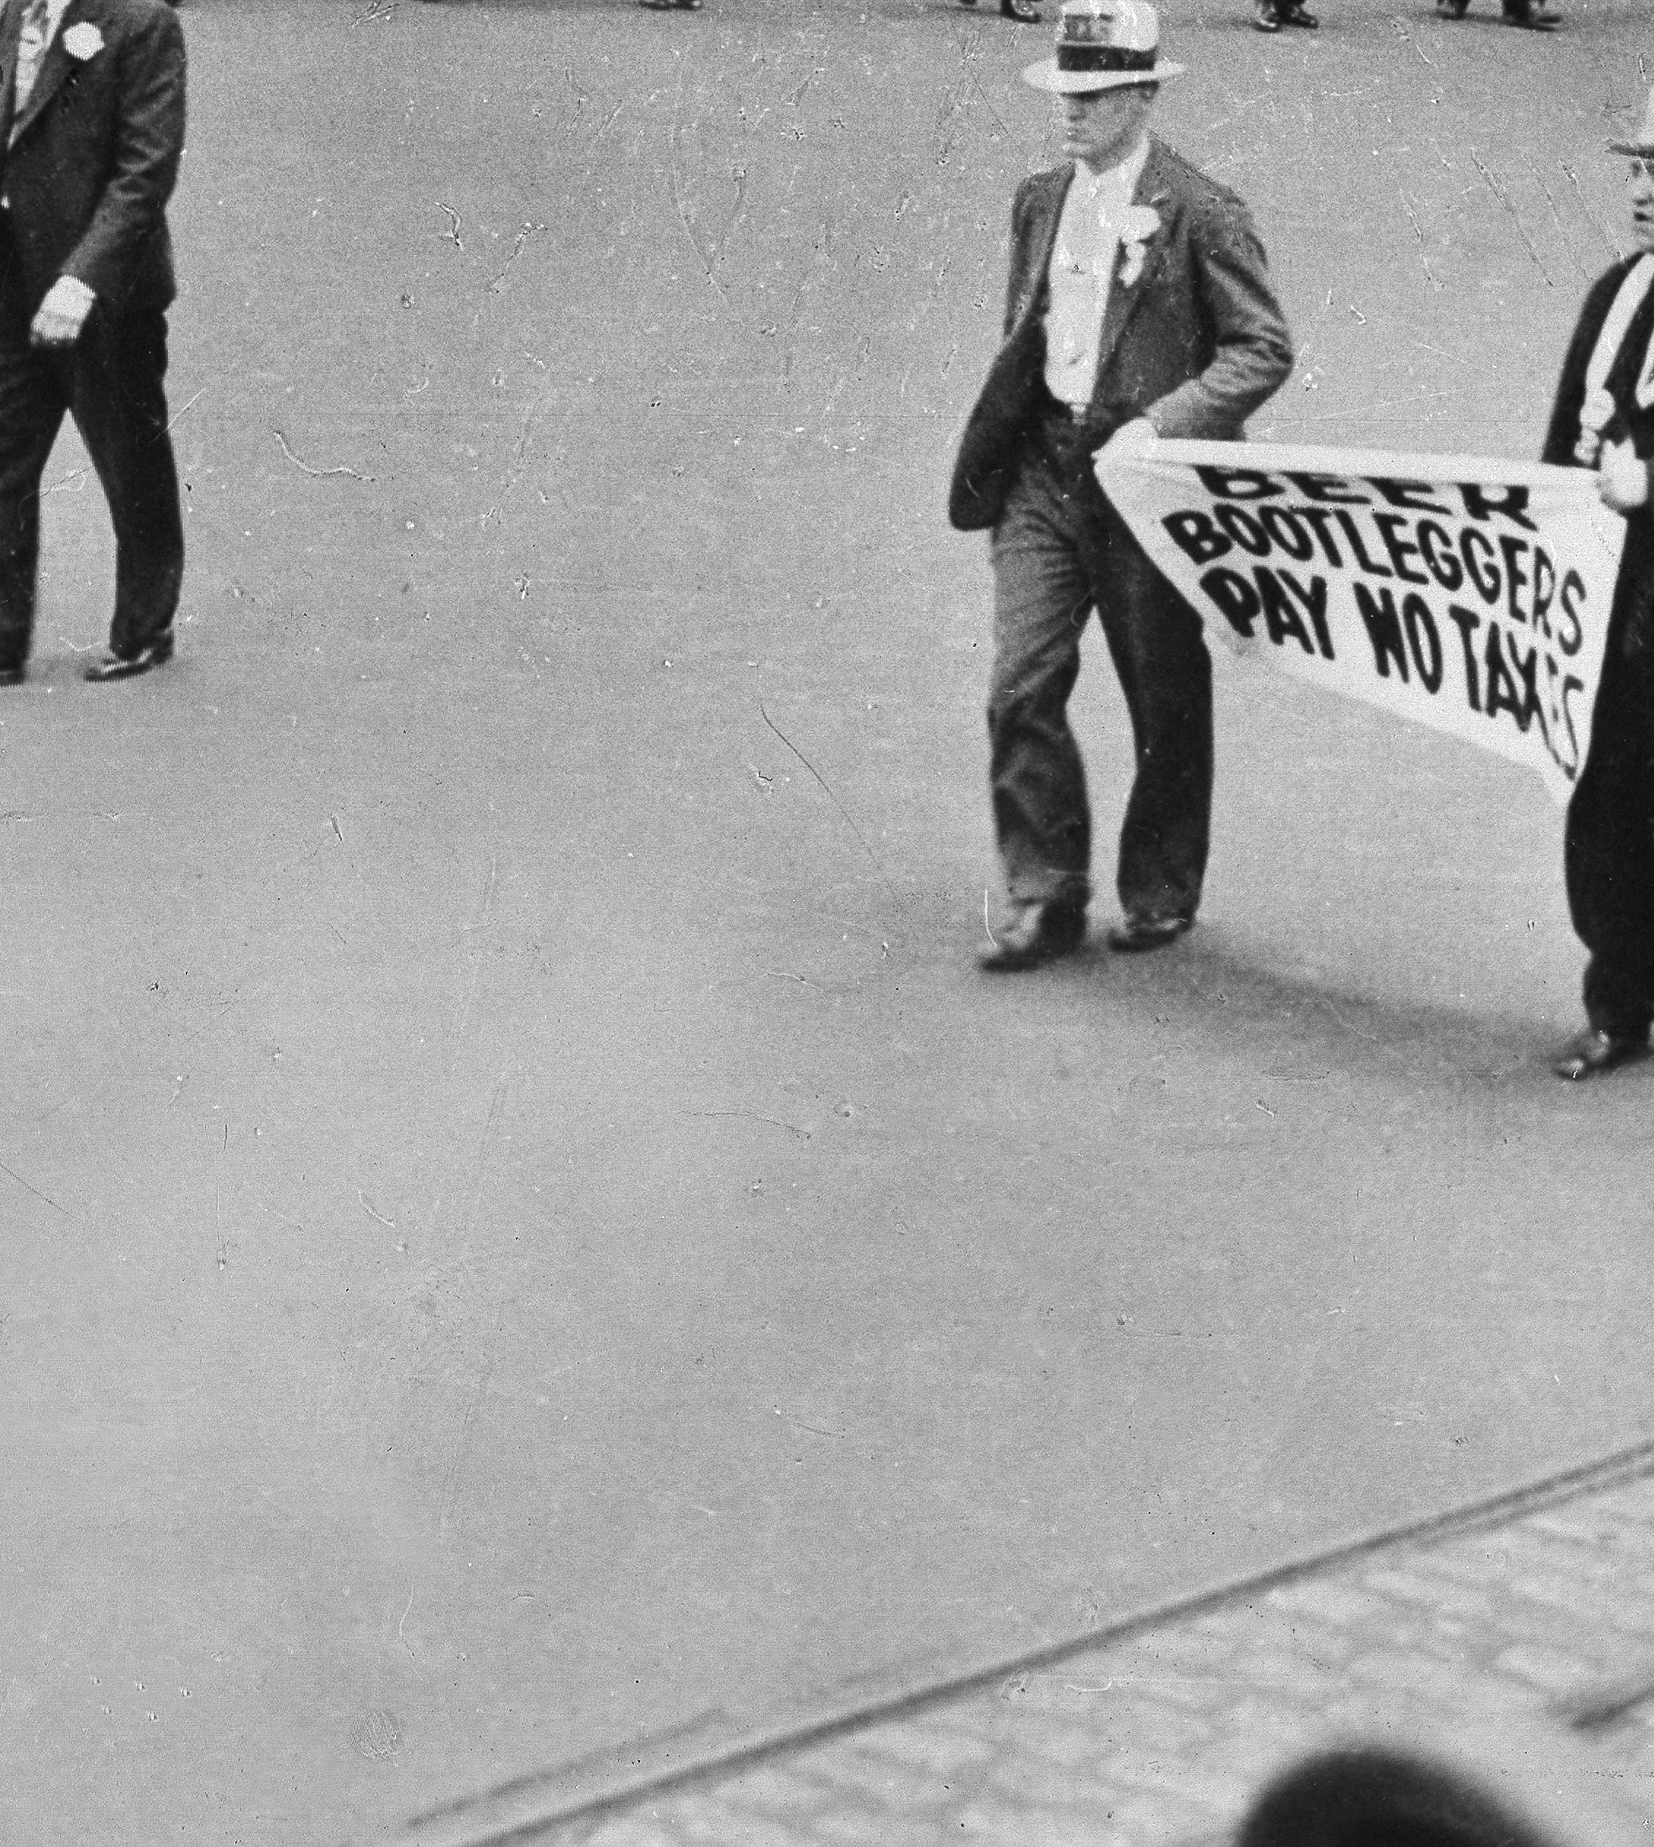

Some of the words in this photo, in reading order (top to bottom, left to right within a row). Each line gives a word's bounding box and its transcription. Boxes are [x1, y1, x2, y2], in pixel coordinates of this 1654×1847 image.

[1162, 503, 1586, 656] BOOTLEGGERS
[1199, 565, 1335, 661] PAY
[1352, 581, 1444, 695] NO
[1449, 604, 1584, 781] TAXS
